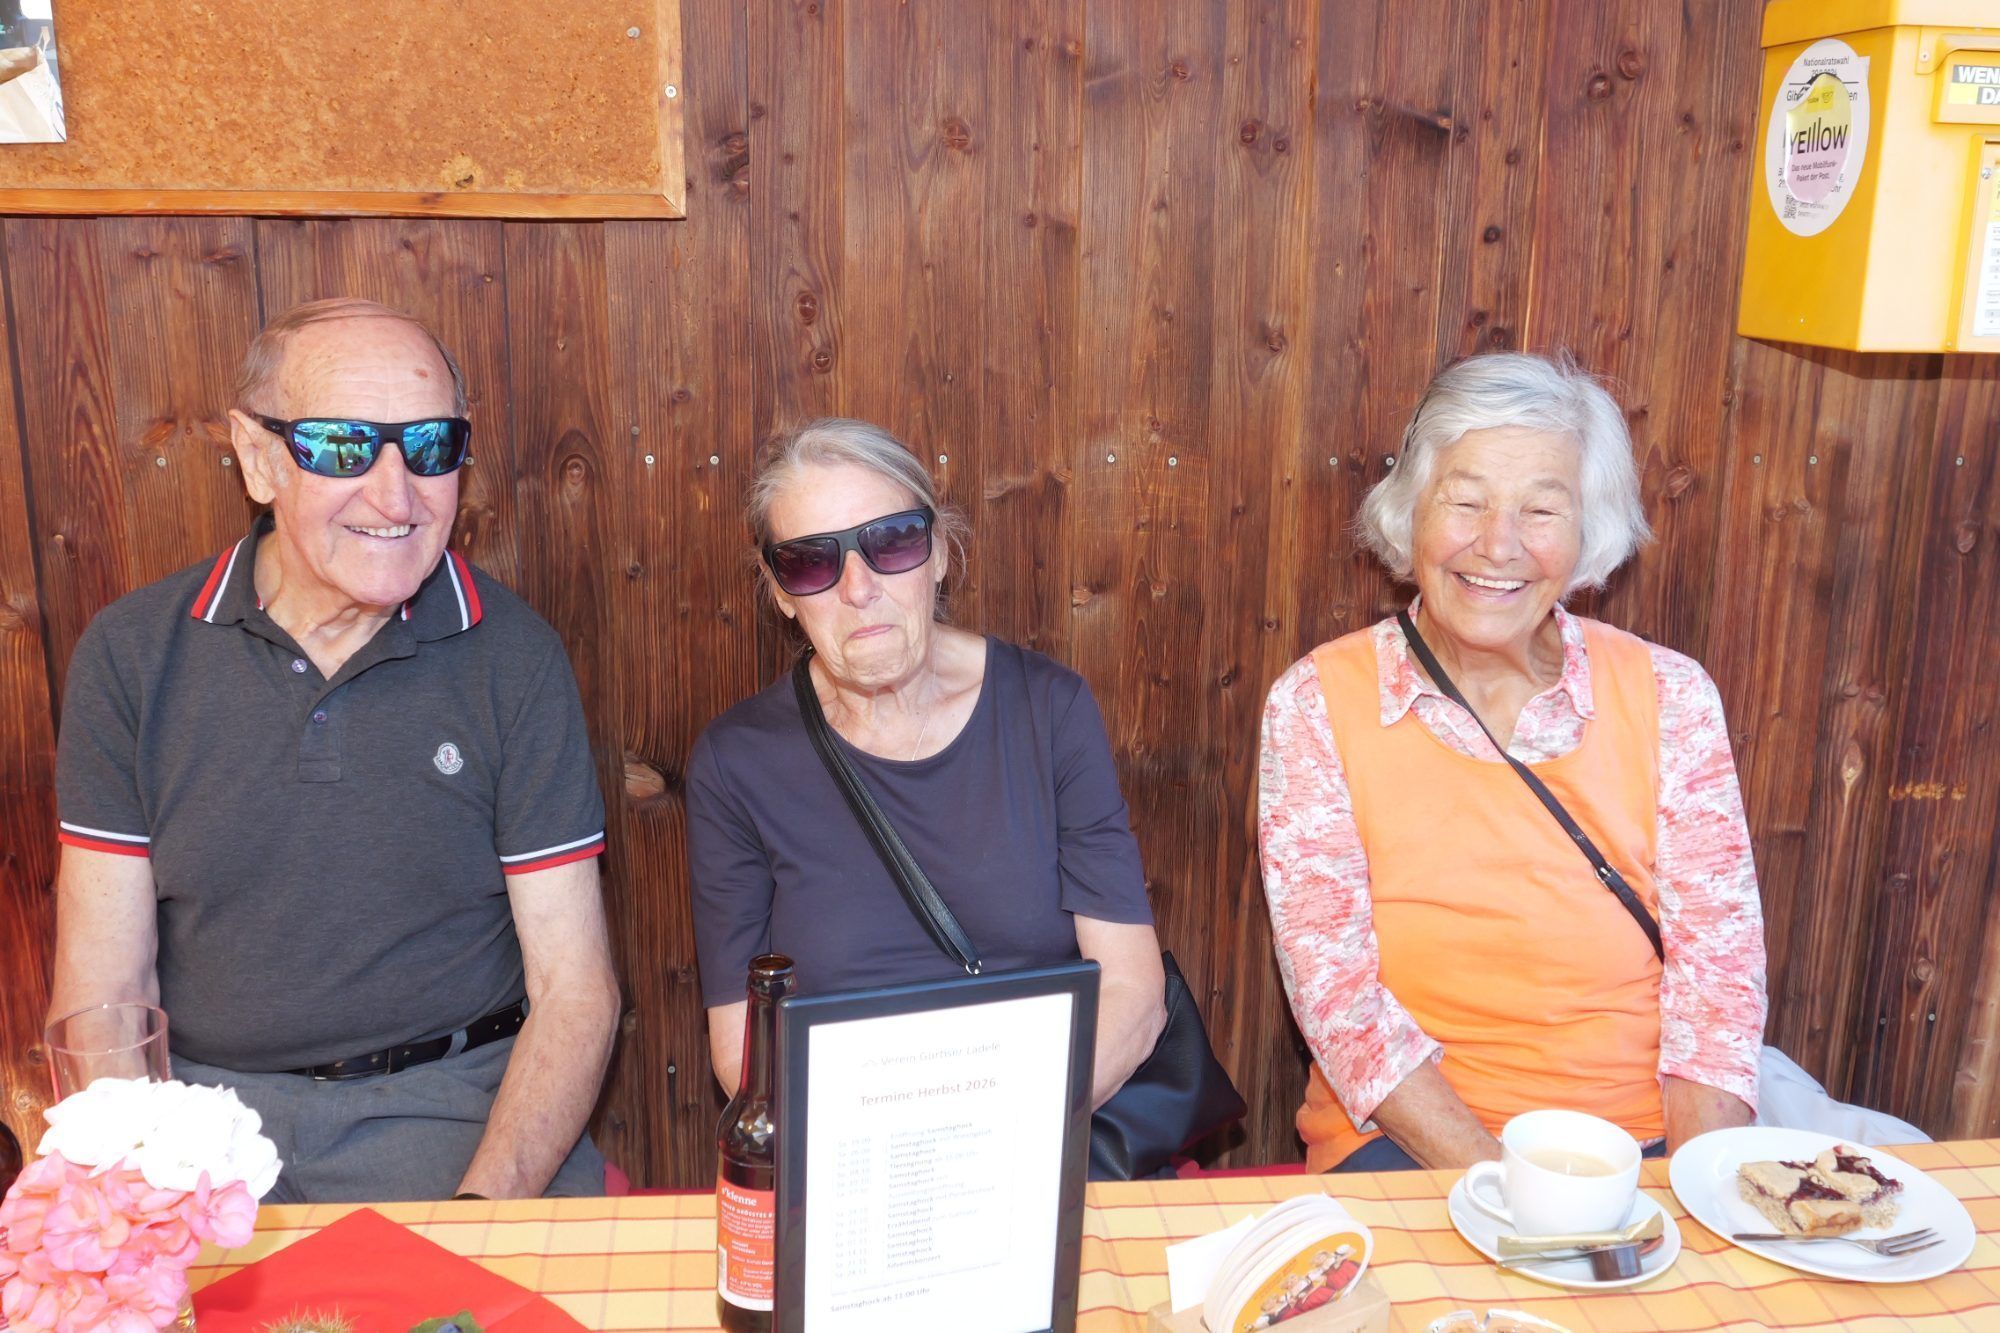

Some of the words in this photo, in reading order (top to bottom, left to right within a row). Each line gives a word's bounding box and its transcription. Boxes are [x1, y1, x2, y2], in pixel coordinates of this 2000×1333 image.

[860, 1090, 913, 1107] Termine
[918, 1083, 961, 1098] Herbst
[965, 1077, 997, 1091] 2026
